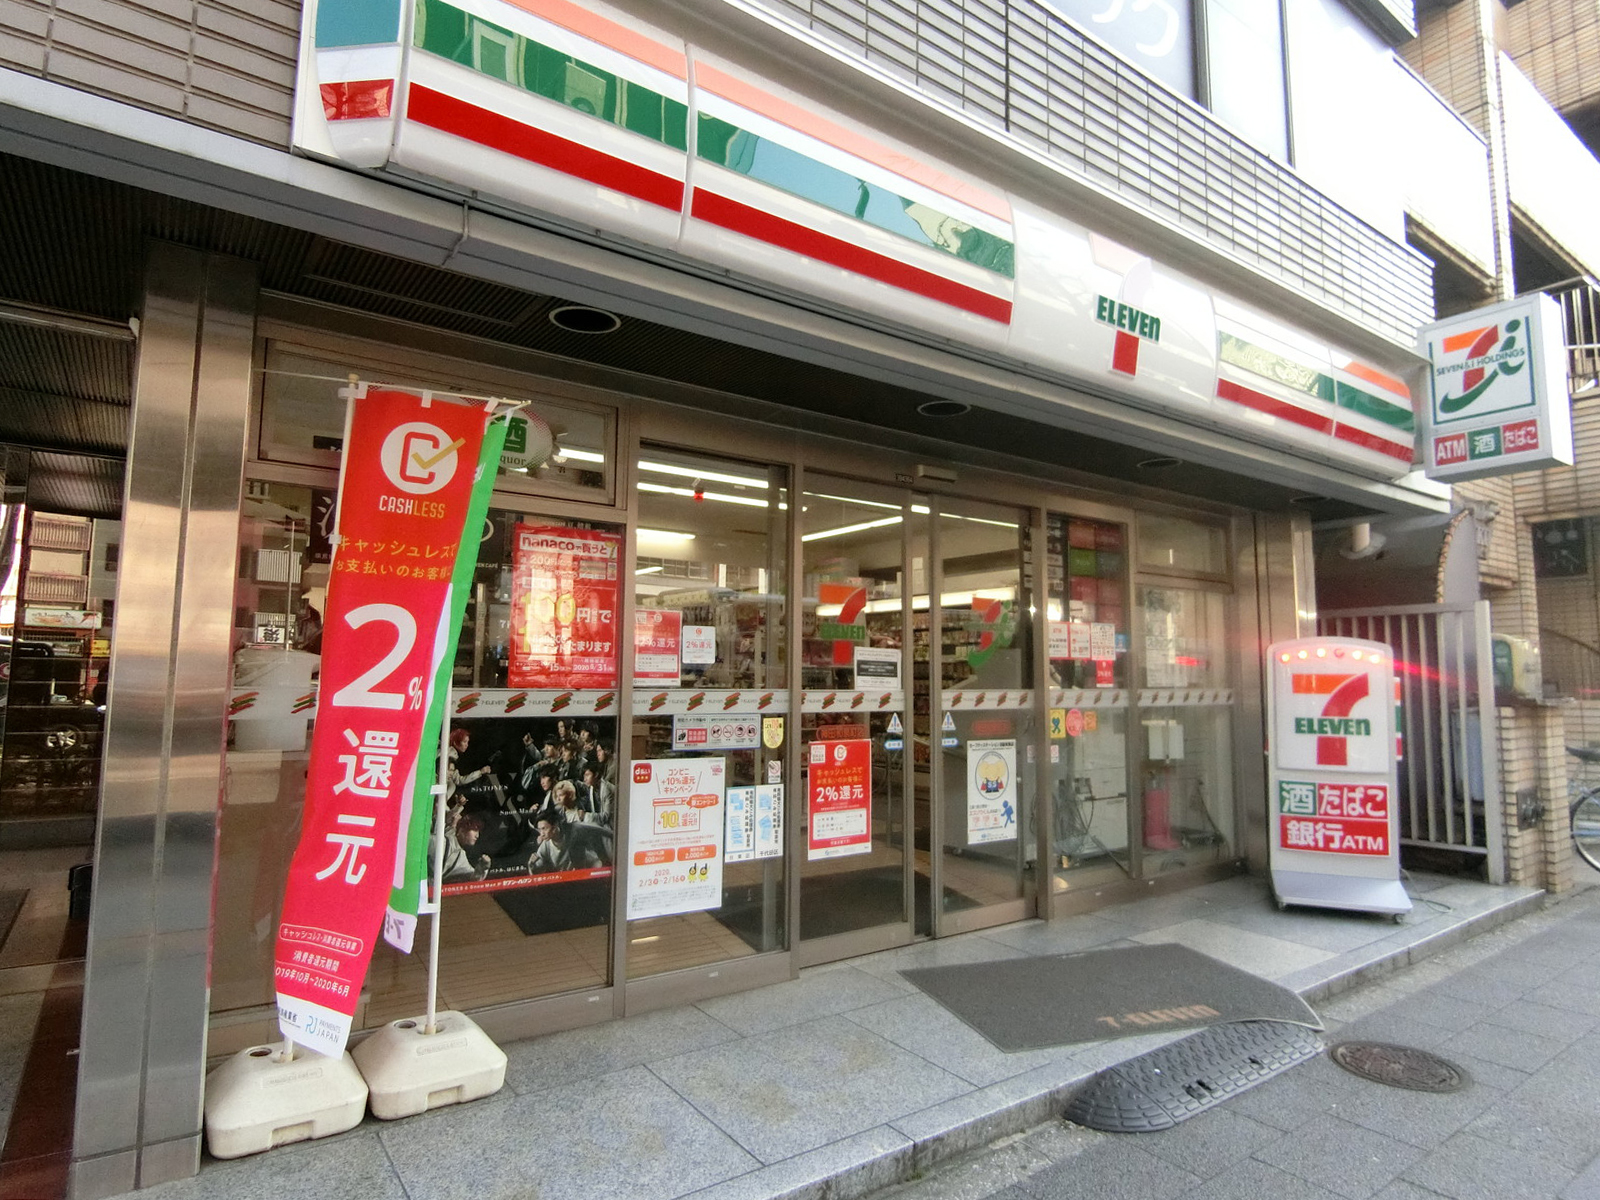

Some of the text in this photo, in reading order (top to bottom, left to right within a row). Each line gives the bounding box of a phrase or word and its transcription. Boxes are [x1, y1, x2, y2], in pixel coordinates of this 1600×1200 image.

[1474, 434, 1495, 454] 酒
[1504, 427, 1537, 449] たばこ
[1437, 439, 1466, 461] ATM
[500, 455, 527, 466] quor
[379, 495, 446, 518] CASHLESS
[668, 768, 690, 777] コンビニ
[816, 766, 863, 776] キャッシュレスで
[661, 776, 696, 786] +10%還元
[663, 785, 693, 794] キャンペーン
[816, 784, 864, 803] 2%還元
[1281, 783, 1386, 816] 酒 たばこ
[1286, 819, 1384, 851] 銀行ATM
[292, 950, 340, 972] 消費者還元期間
[316, 1028, 340, 1044] JAPAN
